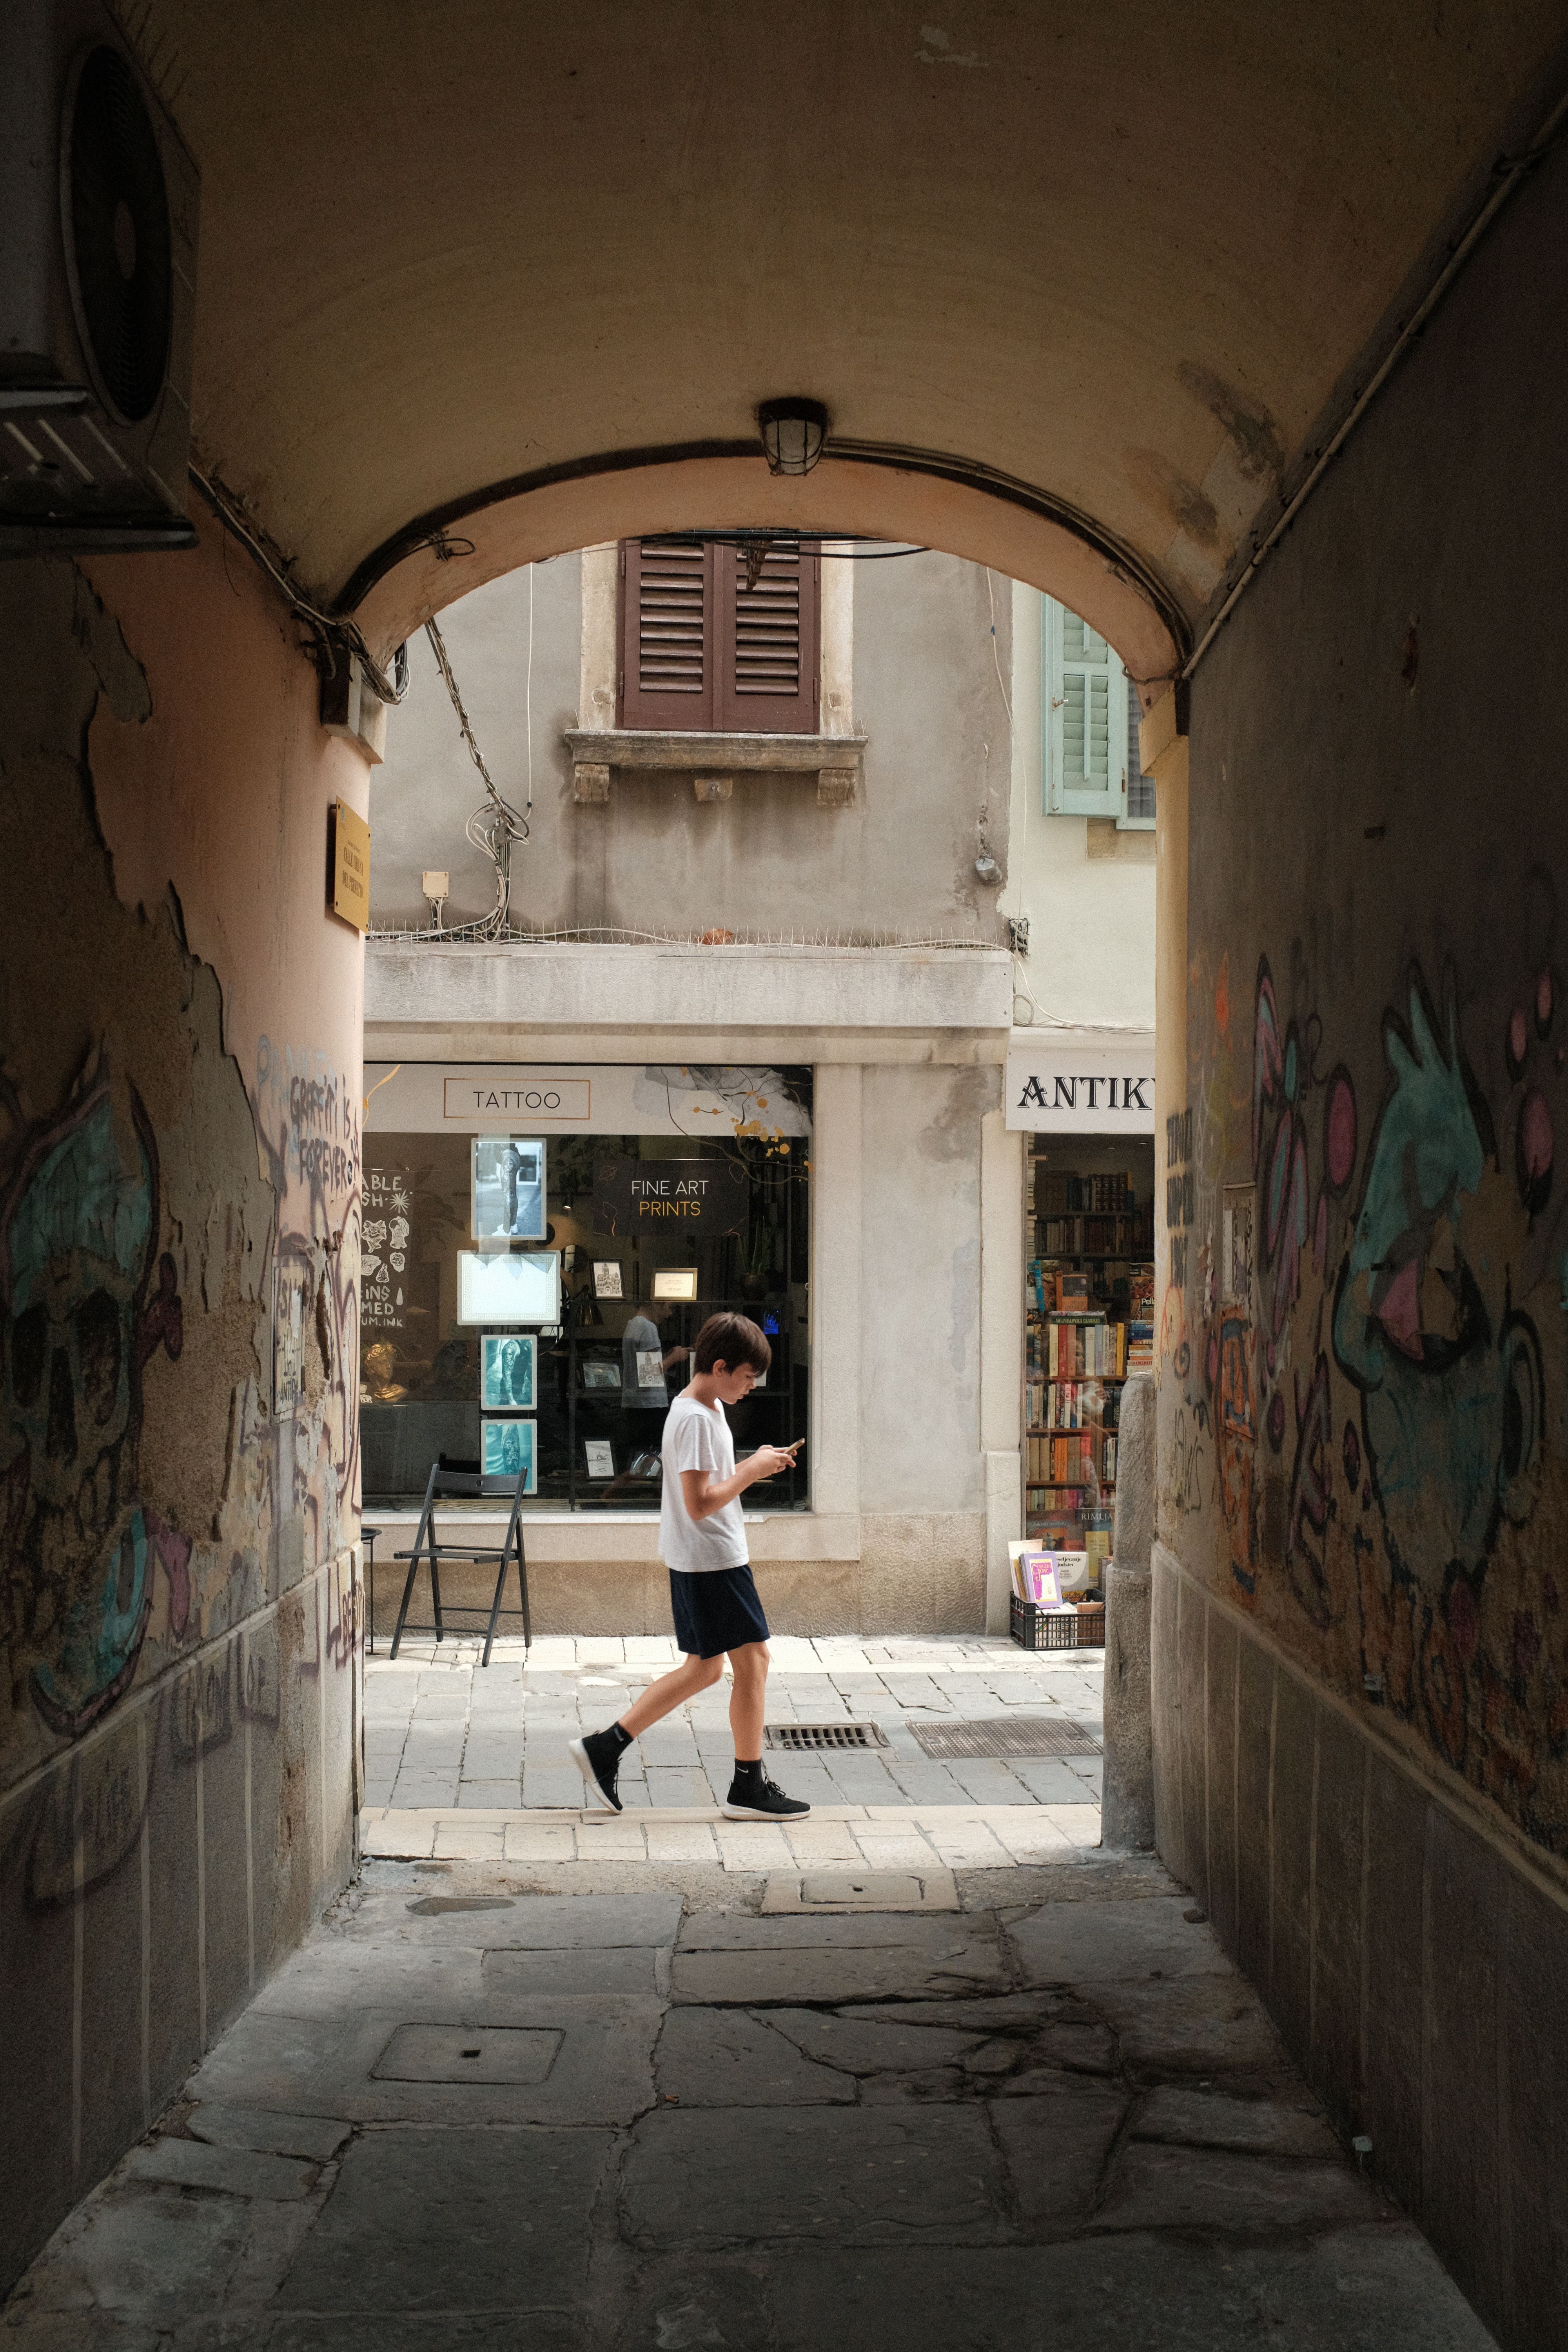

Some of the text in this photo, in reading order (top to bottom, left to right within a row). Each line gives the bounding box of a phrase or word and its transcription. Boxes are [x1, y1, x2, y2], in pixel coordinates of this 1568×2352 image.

[473, 1091, 561, 1109] TATTOO
[1017, 1076, 1155, 1110] ANTIK
[299, 1138, 347, 1193] FOREVER
[632, 1180, 709, 1195] FINE ART
[639, 1201, 701, 1216] PRINTS
[361, 1316, 403, 1327] UM.INK
